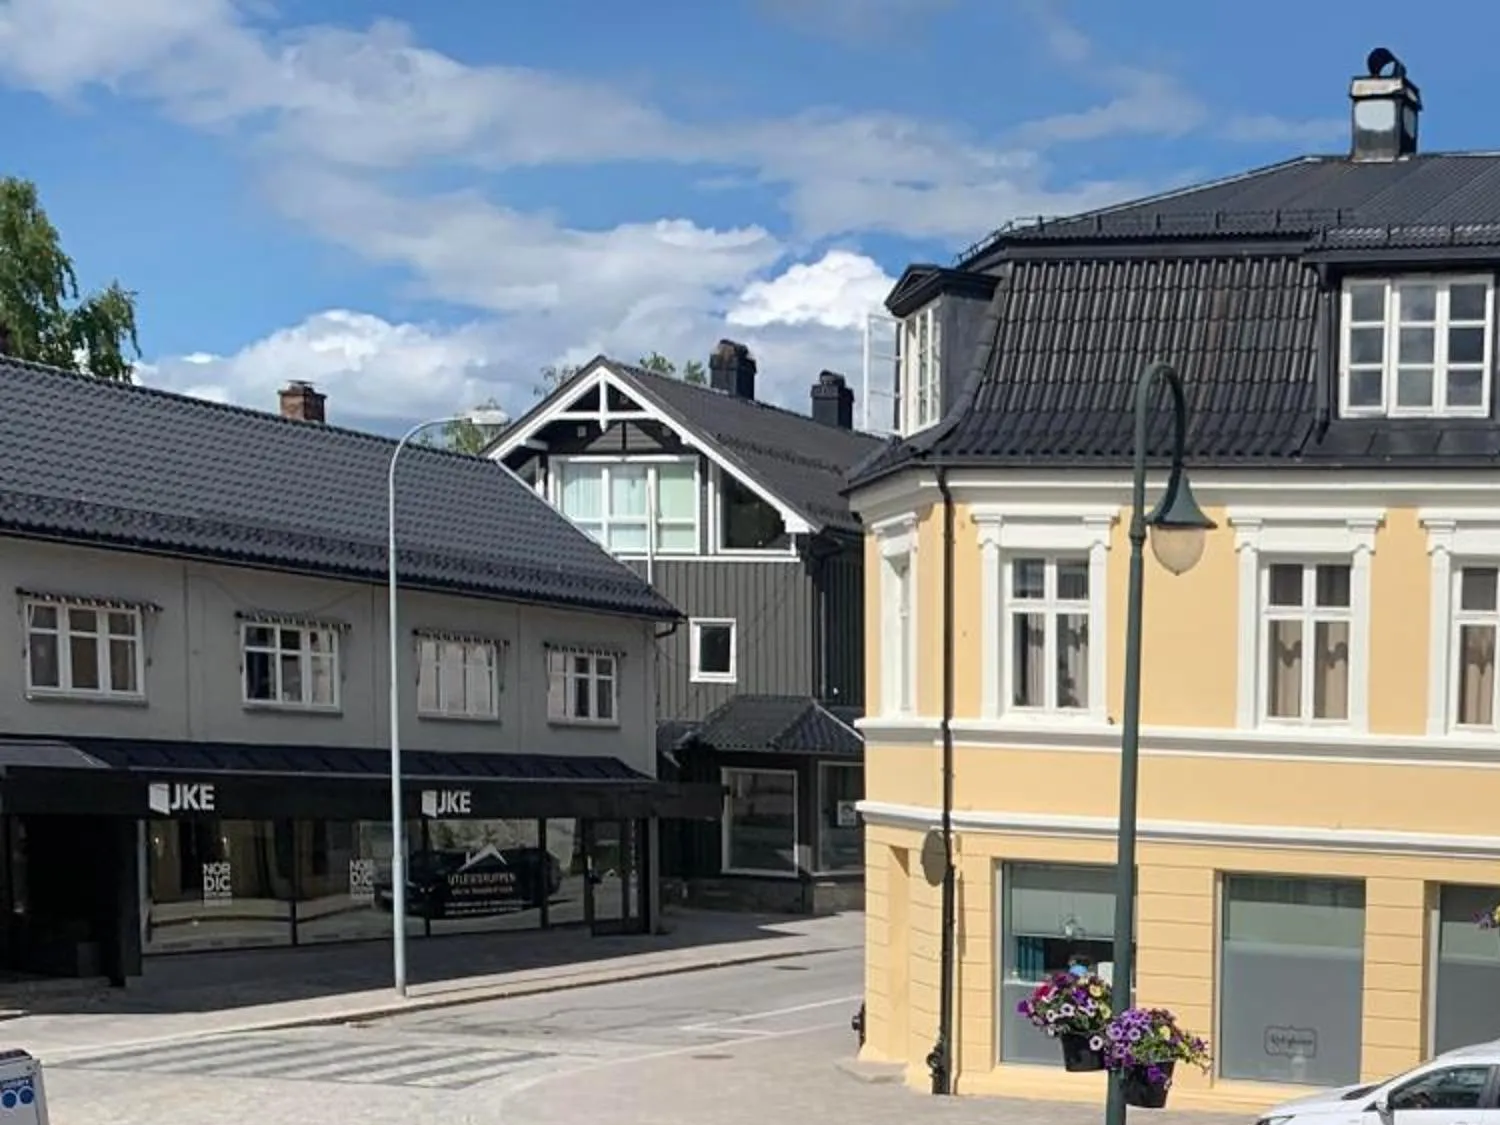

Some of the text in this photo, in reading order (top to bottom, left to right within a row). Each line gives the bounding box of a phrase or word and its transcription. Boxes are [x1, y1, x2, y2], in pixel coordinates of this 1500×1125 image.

[171, 784, 215, 811] JKE
[437, 790, 471, 813] JKE
[203, 862, 231, 876] NOR
[203, 875, 232, 891] DIC
